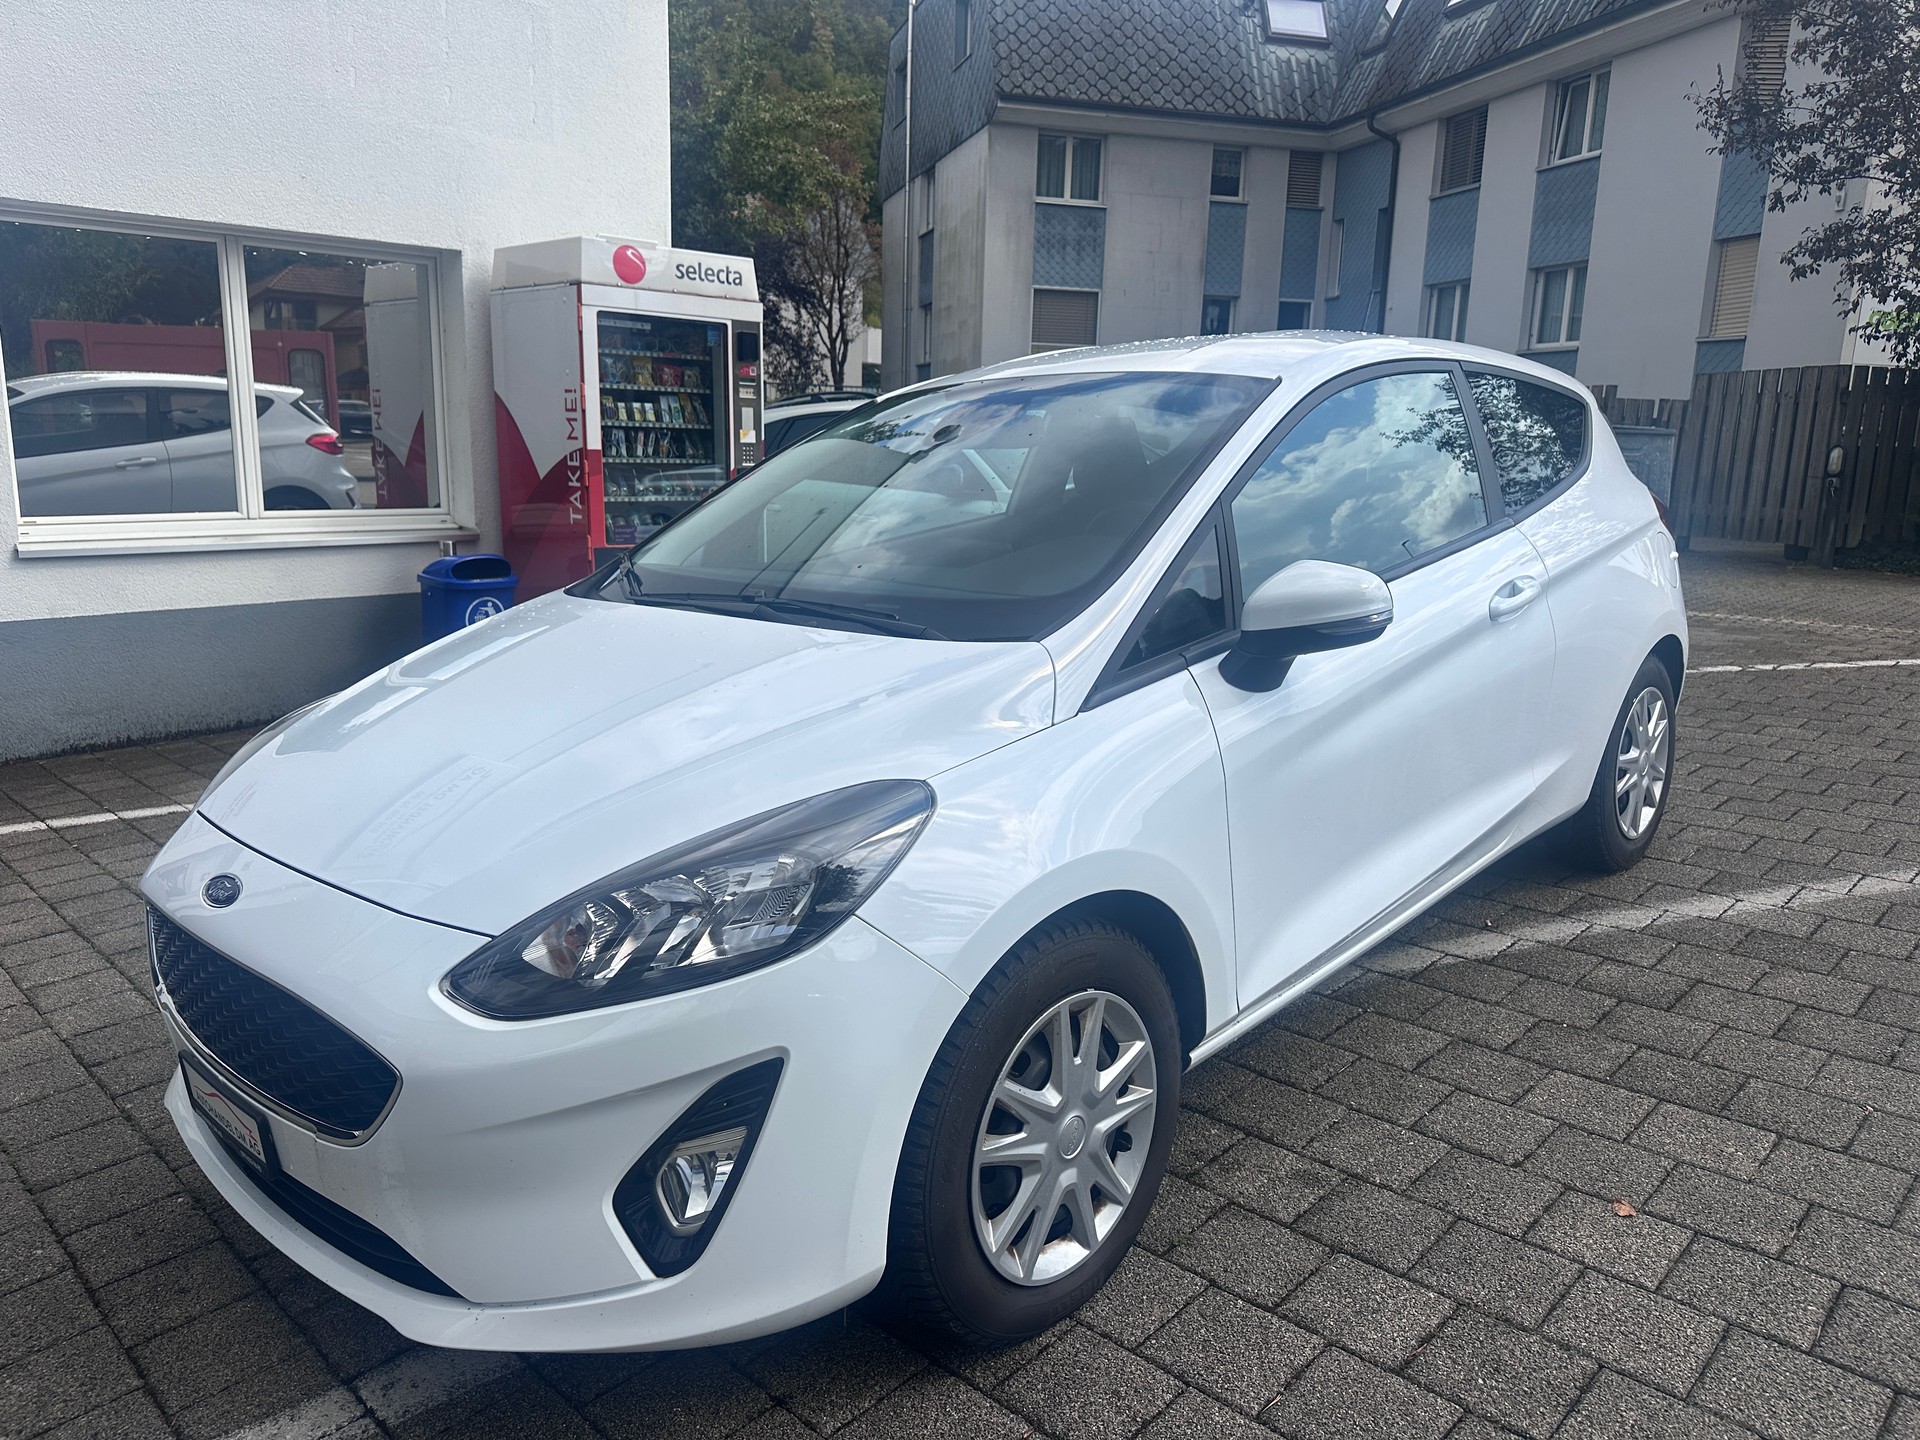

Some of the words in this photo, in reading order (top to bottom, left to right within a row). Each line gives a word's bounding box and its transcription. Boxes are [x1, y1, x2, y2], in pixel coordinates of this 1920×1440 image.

[674, 262, 743, 287] selecta
[564, 387, 579, 441] ME!
[565, 447, 584, 525] TAKE
